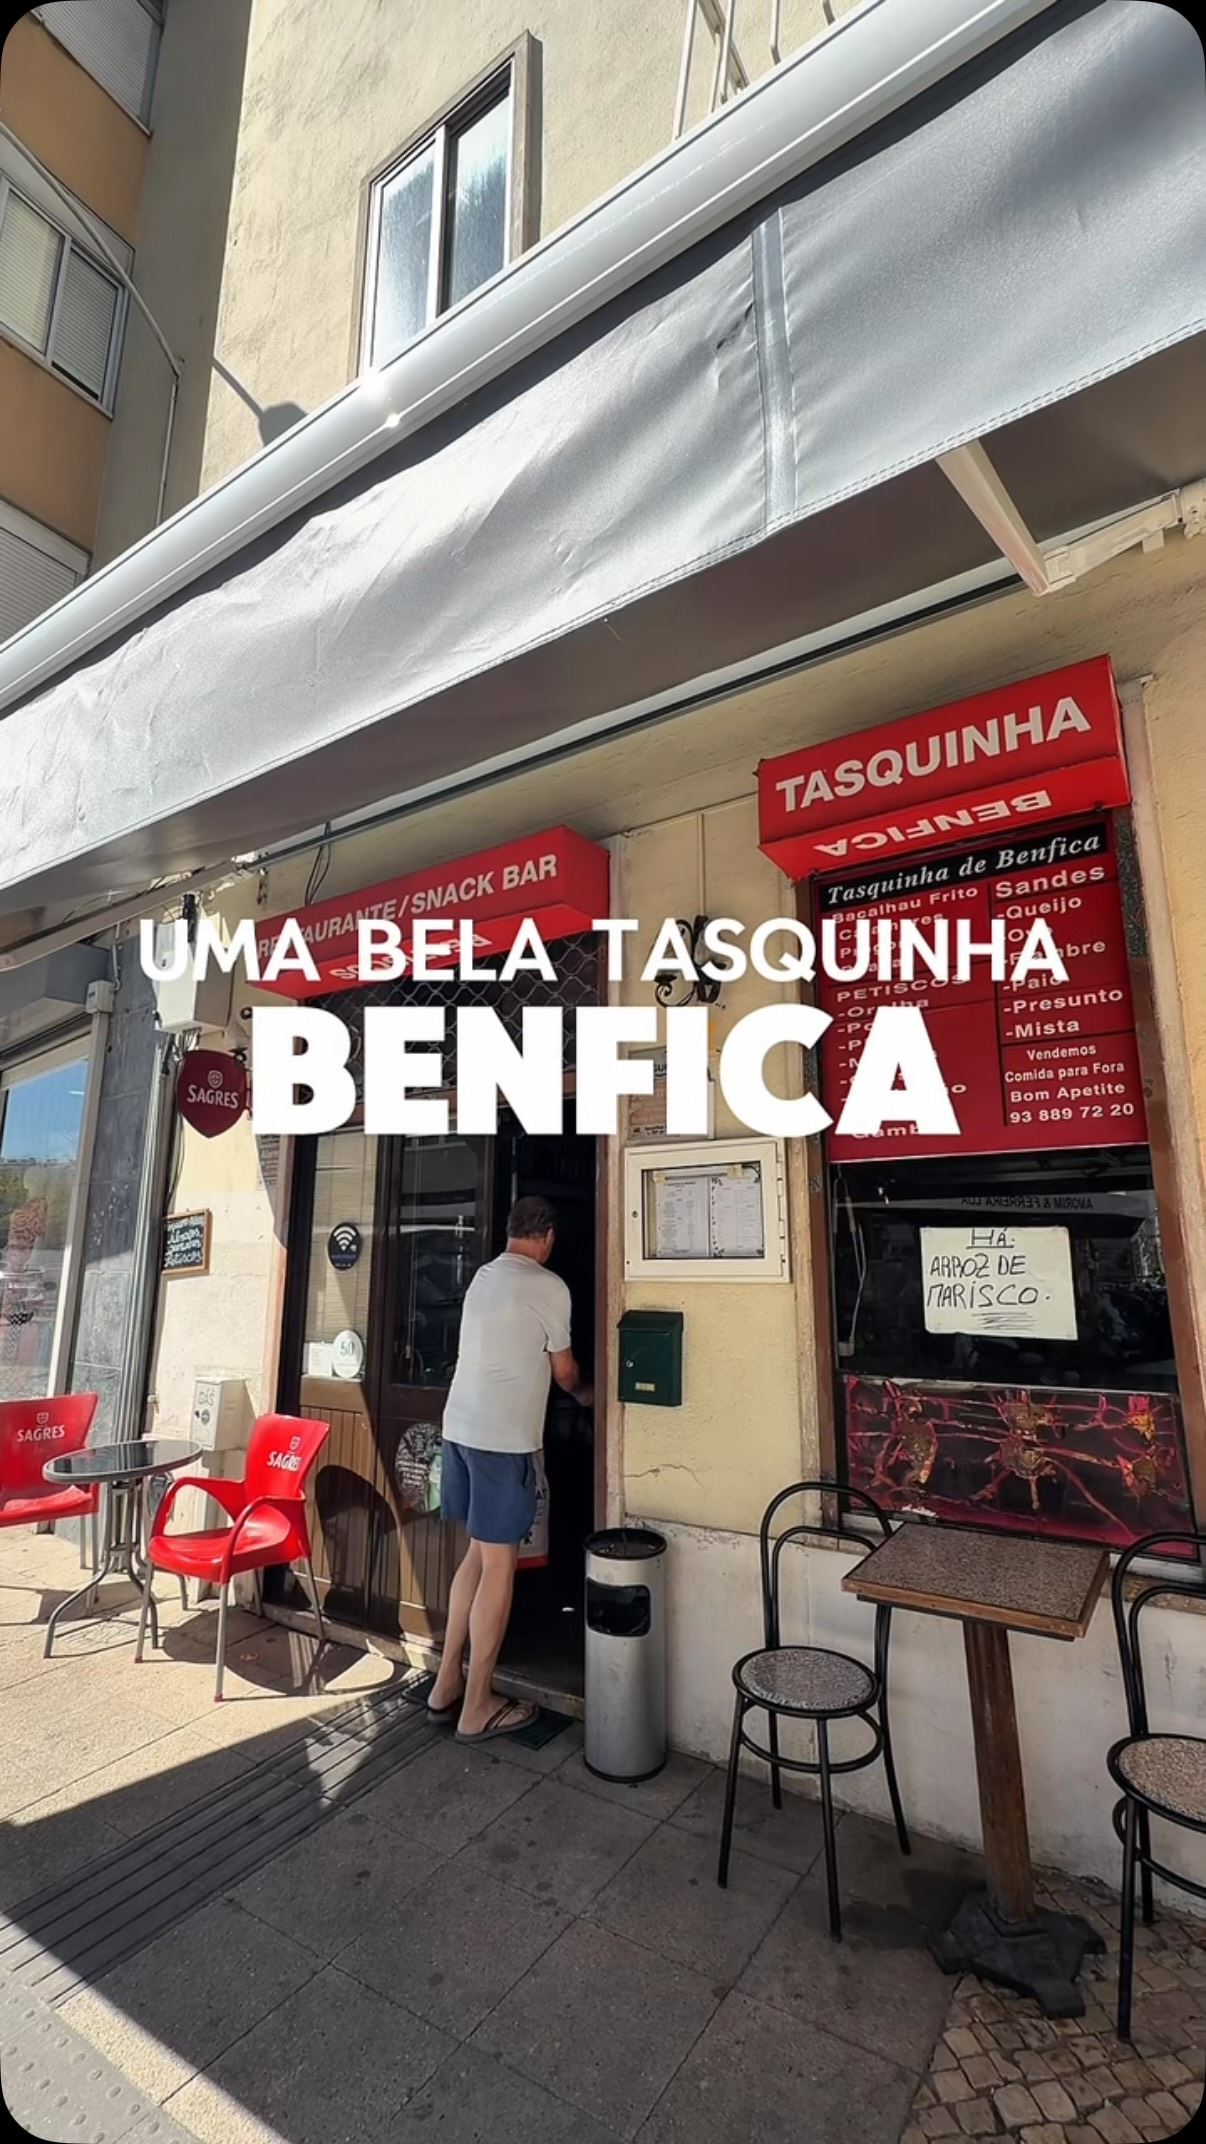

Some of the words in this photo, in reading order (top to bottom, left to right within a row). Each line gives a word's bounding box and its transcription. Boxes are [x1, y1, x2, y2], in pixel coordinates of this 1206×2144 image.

[775, 696, 1091, 812] TASQUINHA
[813, 790, 1051, 857] BENFICA
[502, 854, 557, 890] BAR
[828, 866, 949, 904] Tasquinha
[958, 856, 987, 877] de
[995, 836, 1100, 869] Benfica
[996, 866, 1105, 898] Sandes
[832, 898, 921, 924] Bacalhau
[929, 887, 978, 905] Frito
[997, 897, 1082, 919] -Queijo
[1004, 989, 1123, 1014] -Presunto
[1006, 1019, 1080, 1038] -Mista
[1027, 1045, 1096, 1060] Vendemos
[1005, 1068, 1054, 1082] Comida
[1058, 1066, 1088, 1080] para
[1093, 1062, 1124, 1074] Fora
[187, 1084, 239, 1109] SAGRES
[1010, 1090, 1049, 1102] Bom
[1057, 1083, 1125, 1099] Apetite
[1010, 1111, 1032, 1123] 93
[1039, 1108, 1073, 1121] 889
[1080, 1105, 1103, 1119] 72
[1110, 1103, 1134, 1116] 20
[997, 1254, 1026, 1275] DE
[16, 1424, 65, 1443] SAGRES
